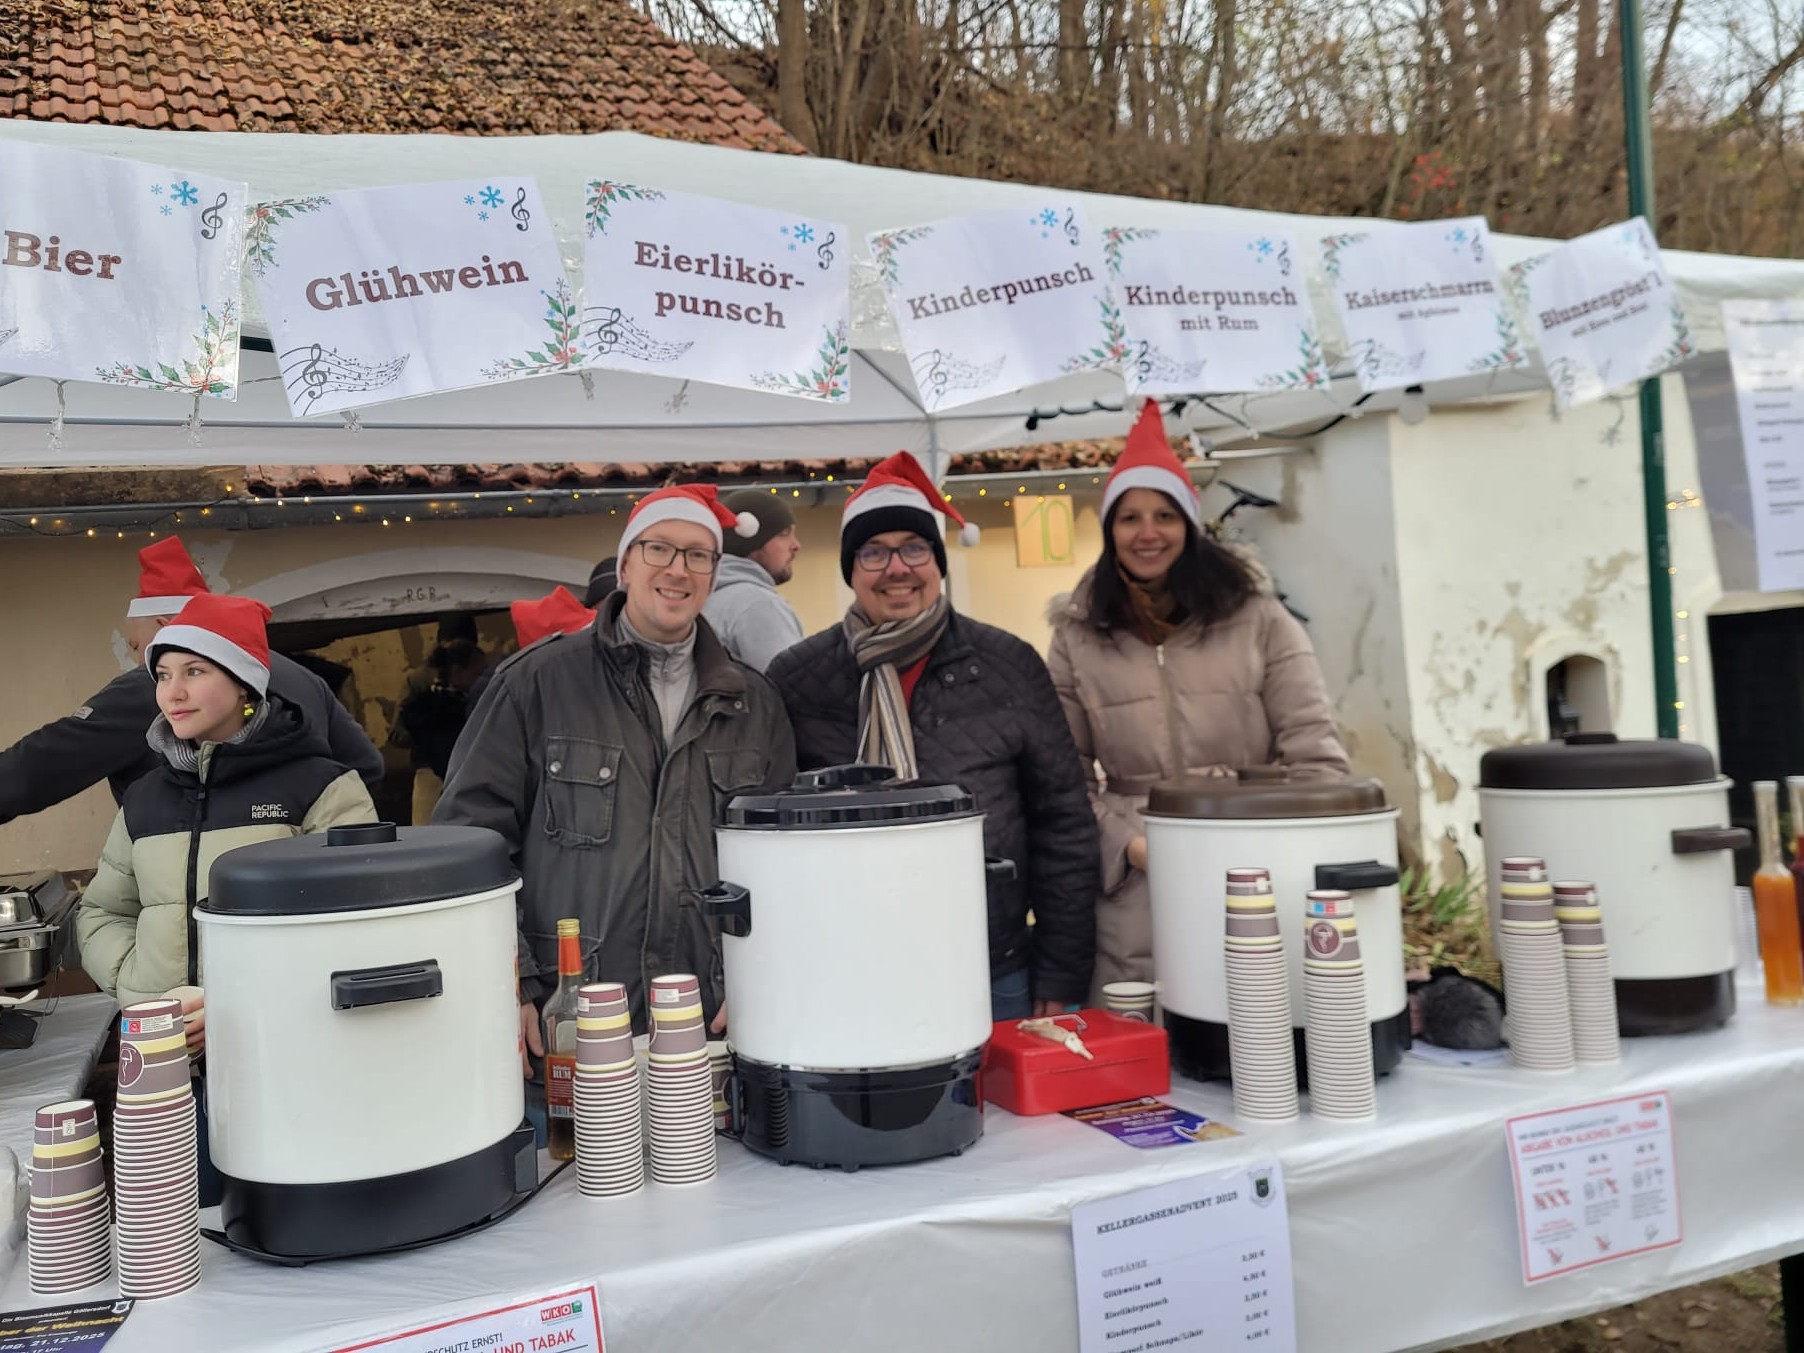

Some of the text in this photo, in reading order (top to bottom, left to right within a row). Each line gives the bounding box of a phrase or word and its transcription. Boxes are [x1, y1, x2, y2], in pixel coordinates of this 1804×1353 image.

[2, 230, 122, 280] Bier
[633, 240, 806, 291] Eierlikör-
[305, 254, 530, 314] Glühwein
[907, 262, 1095, 320] Kinderpunsch
[1125, 285, 1298, 311] Kinderpunsch
[1345, 280, 1495, 310] Kaiserschmarrn
[654, 290, 787, 330] punsch
[1180, 315, 1259, 331] mit Rum
[1020, 499, 1074, 562] 10
[251, 811, 289, 819] REPUBLIC
[541, 1304, 571, 1321] WKO
[30, 1331, 106, 1347] 21.12.2025
[472, 1332, 503, 1349] ERNST!
[528, 1328, 576, 1351] TABAK
